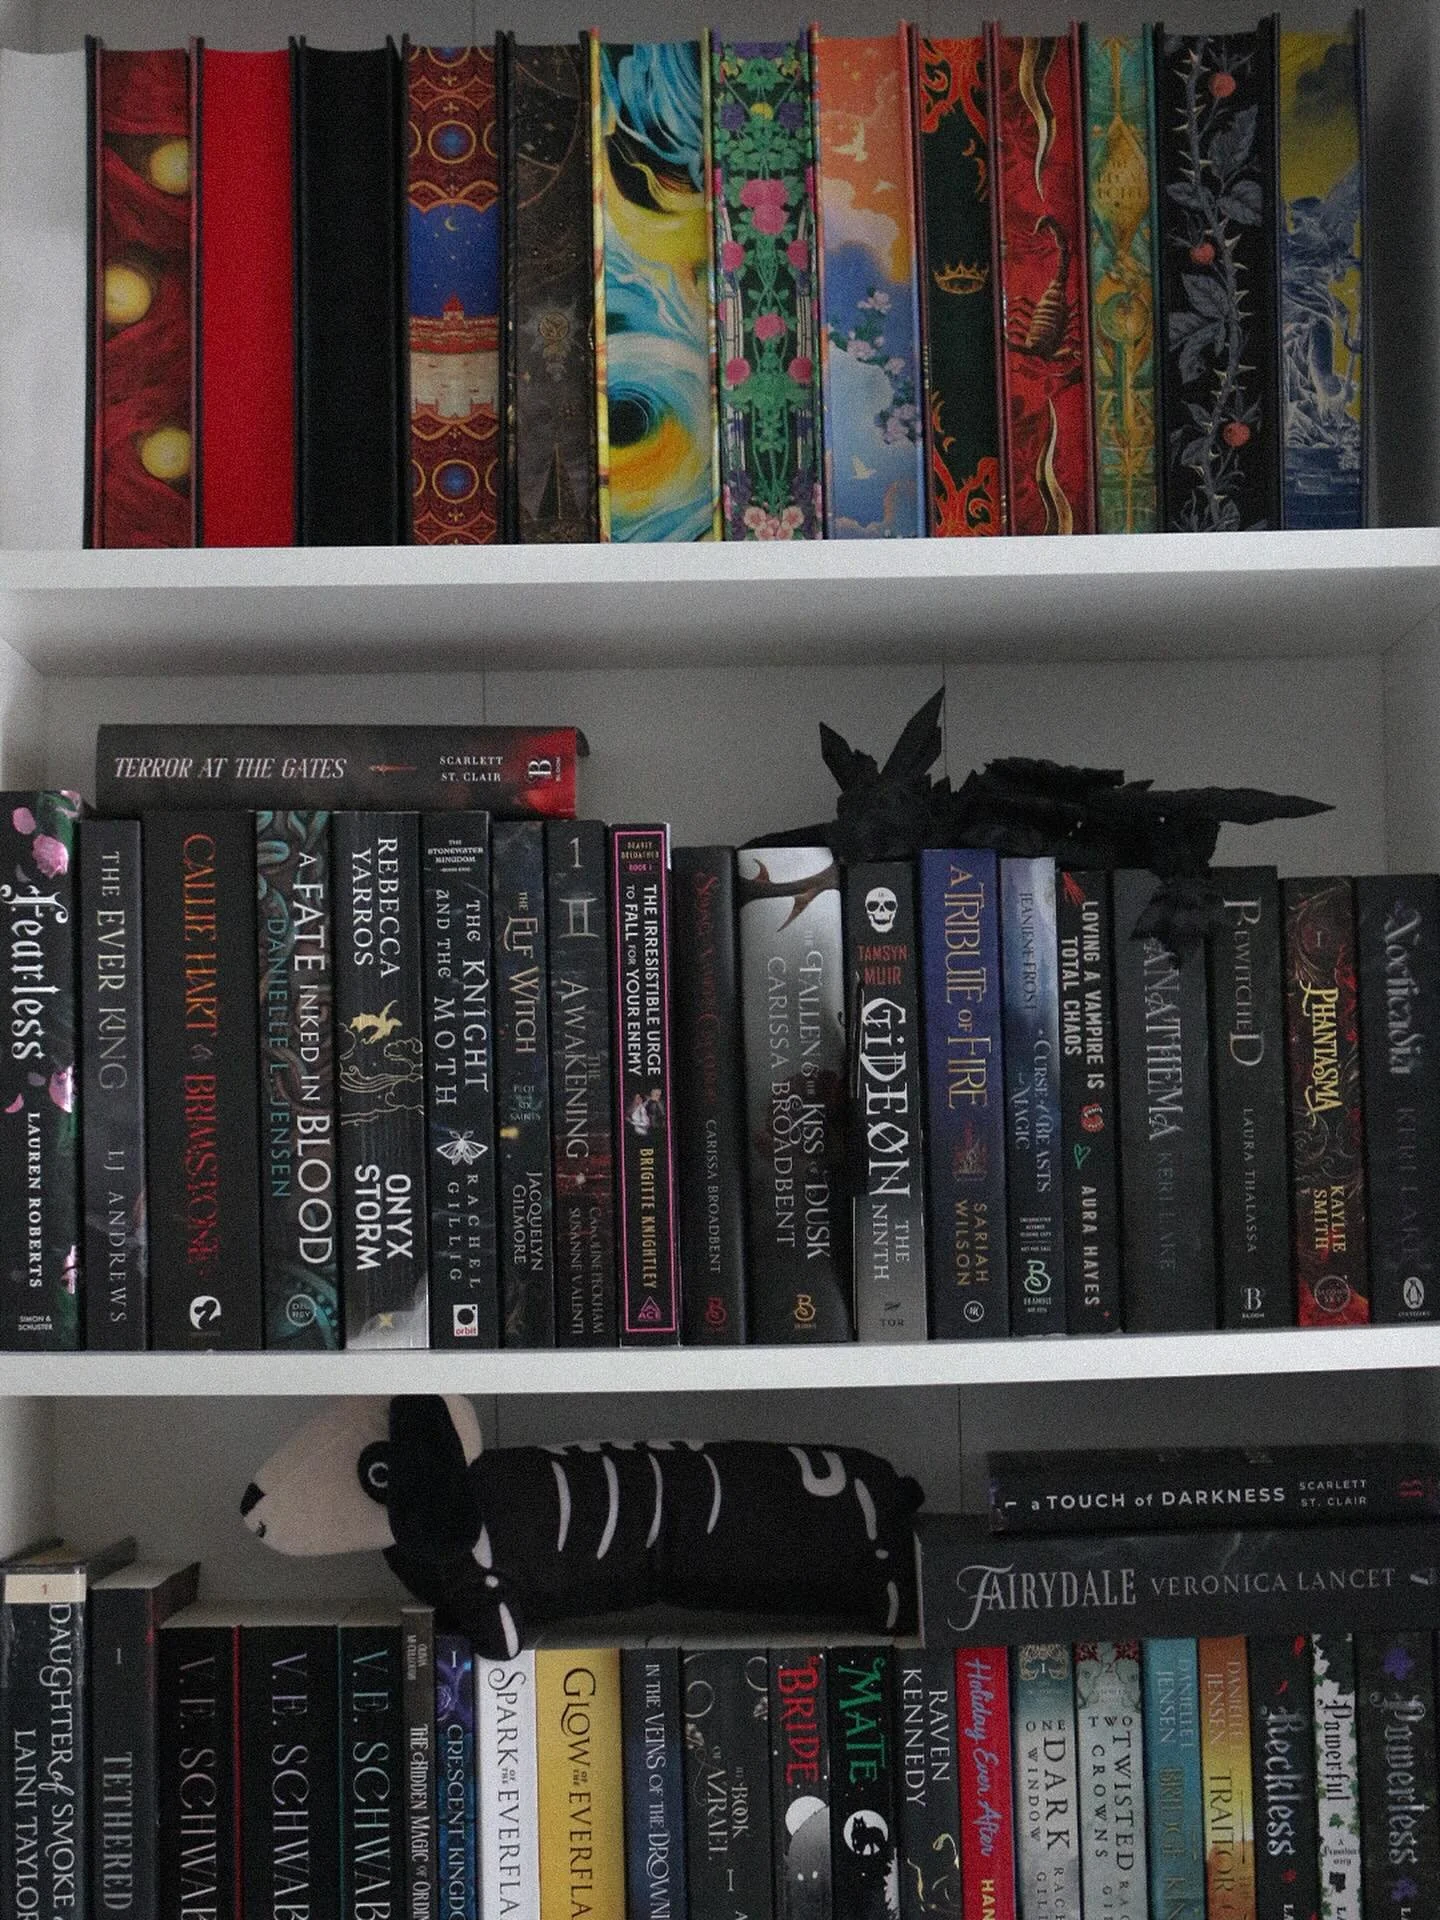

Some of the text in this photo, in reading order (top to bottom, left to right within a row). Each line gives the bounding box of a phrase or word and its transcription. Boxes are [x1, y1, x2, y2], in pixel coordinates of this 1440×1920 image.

[114, 756, 348, 779] TERROR AT THE GATES
[439, 755, 504, 766] SCARLETT
[441, 771, 502, 782] ST. CLAIR
[182, 832, 219, 1040] CALLIE HART
[351, 848, 375, 967] YARROS
[376, 837, 401, 979] REBECCA
[503, 917, 539, 960] ELF
[856, 944, 908, 961] TAMSYN
[0, 884, 69, 1060] Fearless
[96, 852, 128, 1090] THE EVER KING
[461, 899, 490, 1093] THE KNIGHT
[508, 965, 541, 1055] WITCH
[624, 884, 643, 1077] TO FALL FOR YOUR ENEMY
[643, 884, 662, 1076] THE IRRESISTIBLE URGE
[864, 966, 902, 985] MUIR
[943, 866, 993, 1112] A TRIBUTE OF FIRE
[1023, 962, 1040, 1012] FROST
[1060, 936, 1083, 1057] TOTAL CHAOS
[1082, 901, 1105, 1090] LOVING A VAMPIRE IS
[266, 918, 291, 1198] DANIELLE JENSEN
[292, 852, 333, 1264] A FATE INKED IN BLOOD
[434, 937, 458, 1105] THE MOTH
[557, 978, 592, 1159] AWAKENING
[588, 1056, 601, 1080] THE
[1033, 1040, 1051, 1097] CURSE
[1143, 937, 1184, 1141] ANATHEMA
[1301, 981, 1343, 1128] PHANTASMA
[705, 1119, 718, 1180] CARISSA
[766, 956, 796, 1248] CARISSA BROADBENT
[788, 951, 832, 1261] FALLEN KISS DUSK
[1011, 1084, 1032, 1151] MAGIC
[28, 1112, 44, 1289] LAUREN ROBERTS
[182, 1073, 220, 1268] BRIMSTONE
[1034, 1114, 1055, 1193] BEASTS
[1242, 1108, 1258, 1253] LAURA THALASSA
[108, 1191, 128, 1323] ANDREWS
[354, 1164, 382, 1271] STORM
[385, 1173, 414, 1260] ONYX
[447, 1182, 463, 1282] GILLIG
[467, 1173, 482, 1289] RACHEL
[512, 1184, 529, 1265] GILMORE
[526, 1171, 545, 1272] JACQUELYN
[639, 1148, 658, 1289] BRIGITTE KNIGHTLEY
[708, 1185, 722, 1274] BROADBENT
[870, 1203, 889, 1281] NINTH
[893, 1220, 910, 1263] THE
[954, 1200, 971, 1286] WILSON
[973, 1202, 989, 1283] SARIAH
[1081, 1185, 1101, 1306] AURA HAYES
[1313, 1189, 1330, 1250] SMITH
[1330, 1184, 1347, 1253] KAYLIE
[1032, 1487, 1287, 1511] a TOUCH of DARKNESS
[1299, 1478, 1368, 1491] SCARLETT
[1301, 1495, 1368, 1508] ST. CLAIR
[946, 1561, 1396, 1631] FAIRYDALE VERONICA LANCET
[488, 1668, 528, 1767] SPARK
[561, 1667, 597, 1767] GLOW
[644, 1663, 662, 1677] IN
[645, 1680, 662, 1709] THE
[964, 1658, 997, 1743] Holiday
[1159, 1671, 1178, 1744] JENSEN
[1205, 1674, 1227, 1746] JENSEN
[38, 1603, 76, 1909] DAUGHTER of SMOKE
[410, 1723, 430, 1751] THE
[644, 1711, 667, 1771] VEINS
[776, 1655, 823, 1787] BRIDE
[837, 1656, 889, 1786] MATE
[902, 1668, 927, 1808] KENNEDY
[928, 1689, 951, 1782] RAVEN
[1026, 1720, 1067, 1733] ONE
[1088, 1715, 1134, 1728] TWO
[1317, 1700, 1354, 1802] Powerful
[411, 1751, 430, 1810] HIDDEN
[447, 1723, 465, 1840] CRESCENT
[647, 1773, 665, 1797] OF
[649, 1801, 666, 1829] THE
[706, 1766, 729, 1861] AZRAEL
[730, 1783, 750, 1839] BOOK
[973, 1747, 1000, 1796] Ever
[1026, 1747, 1042, 1844] WINDOW
[1043, 1737, 1071, 1852] DARK
[1091, 1744, 1109, 1859] CROWNS
[1114, 1731, 1136, 1872] TWISTED
[1260, 1703, 1307, 1857] Reckless
[1370, 1690, 1431, 1865] Powerless
[14, 1729, 38, 1920] LAINI TAYLOR
[102, 1751, 134, 1911] TETHERED
[271, 1743, 310, 1920] SCHWAB
[352, 1741, 391, 1920] SCHWAB
[410, 1815, 431, 1862] MAGIC
[971, 1800, 1004, 1857] After
[1209, 1768, 1236, 1893] TRAITOR
